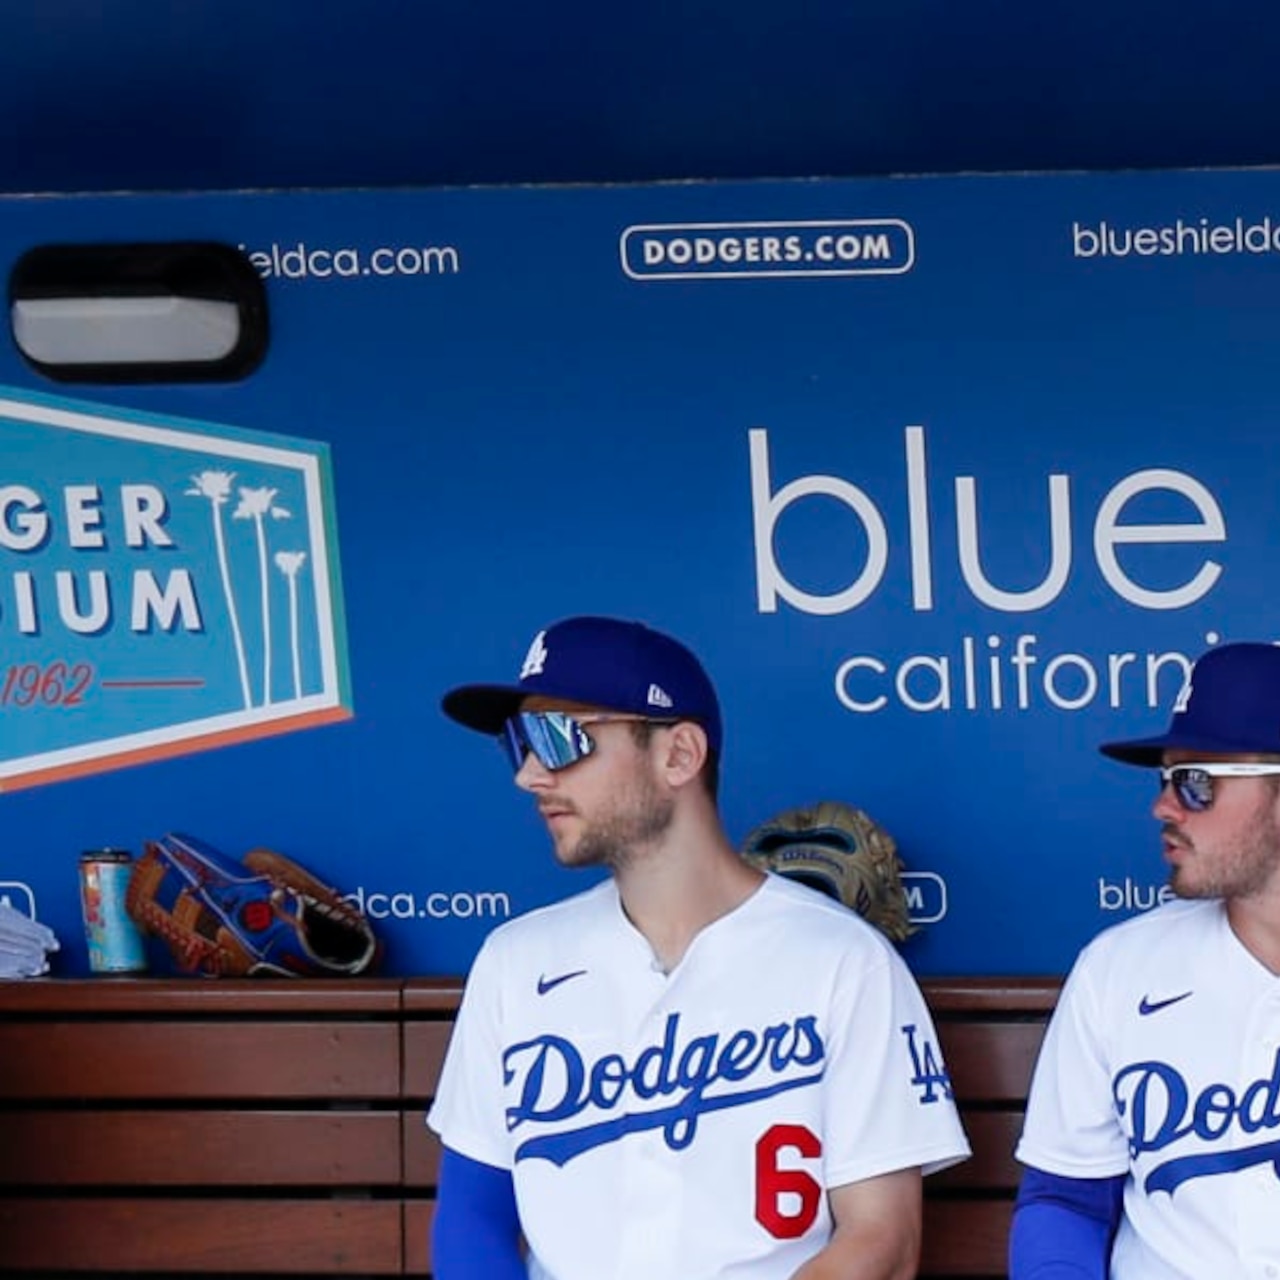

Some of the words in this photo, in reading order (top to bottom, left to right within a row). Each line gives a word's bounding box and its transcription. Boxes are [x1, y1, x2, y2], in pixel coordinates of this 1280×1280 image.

[239, 243, 459, 278] eldca.com
[643, 234, 891, 265] DODGERS.COM
[748, 426, 1227, 616] blue
[0, 661, 93, 707] 1962
[503, 1012, 826, 1152] Dodgers
[901, 1023, 955, 1103] LA
[754, 1123, 822, 1240] 6
